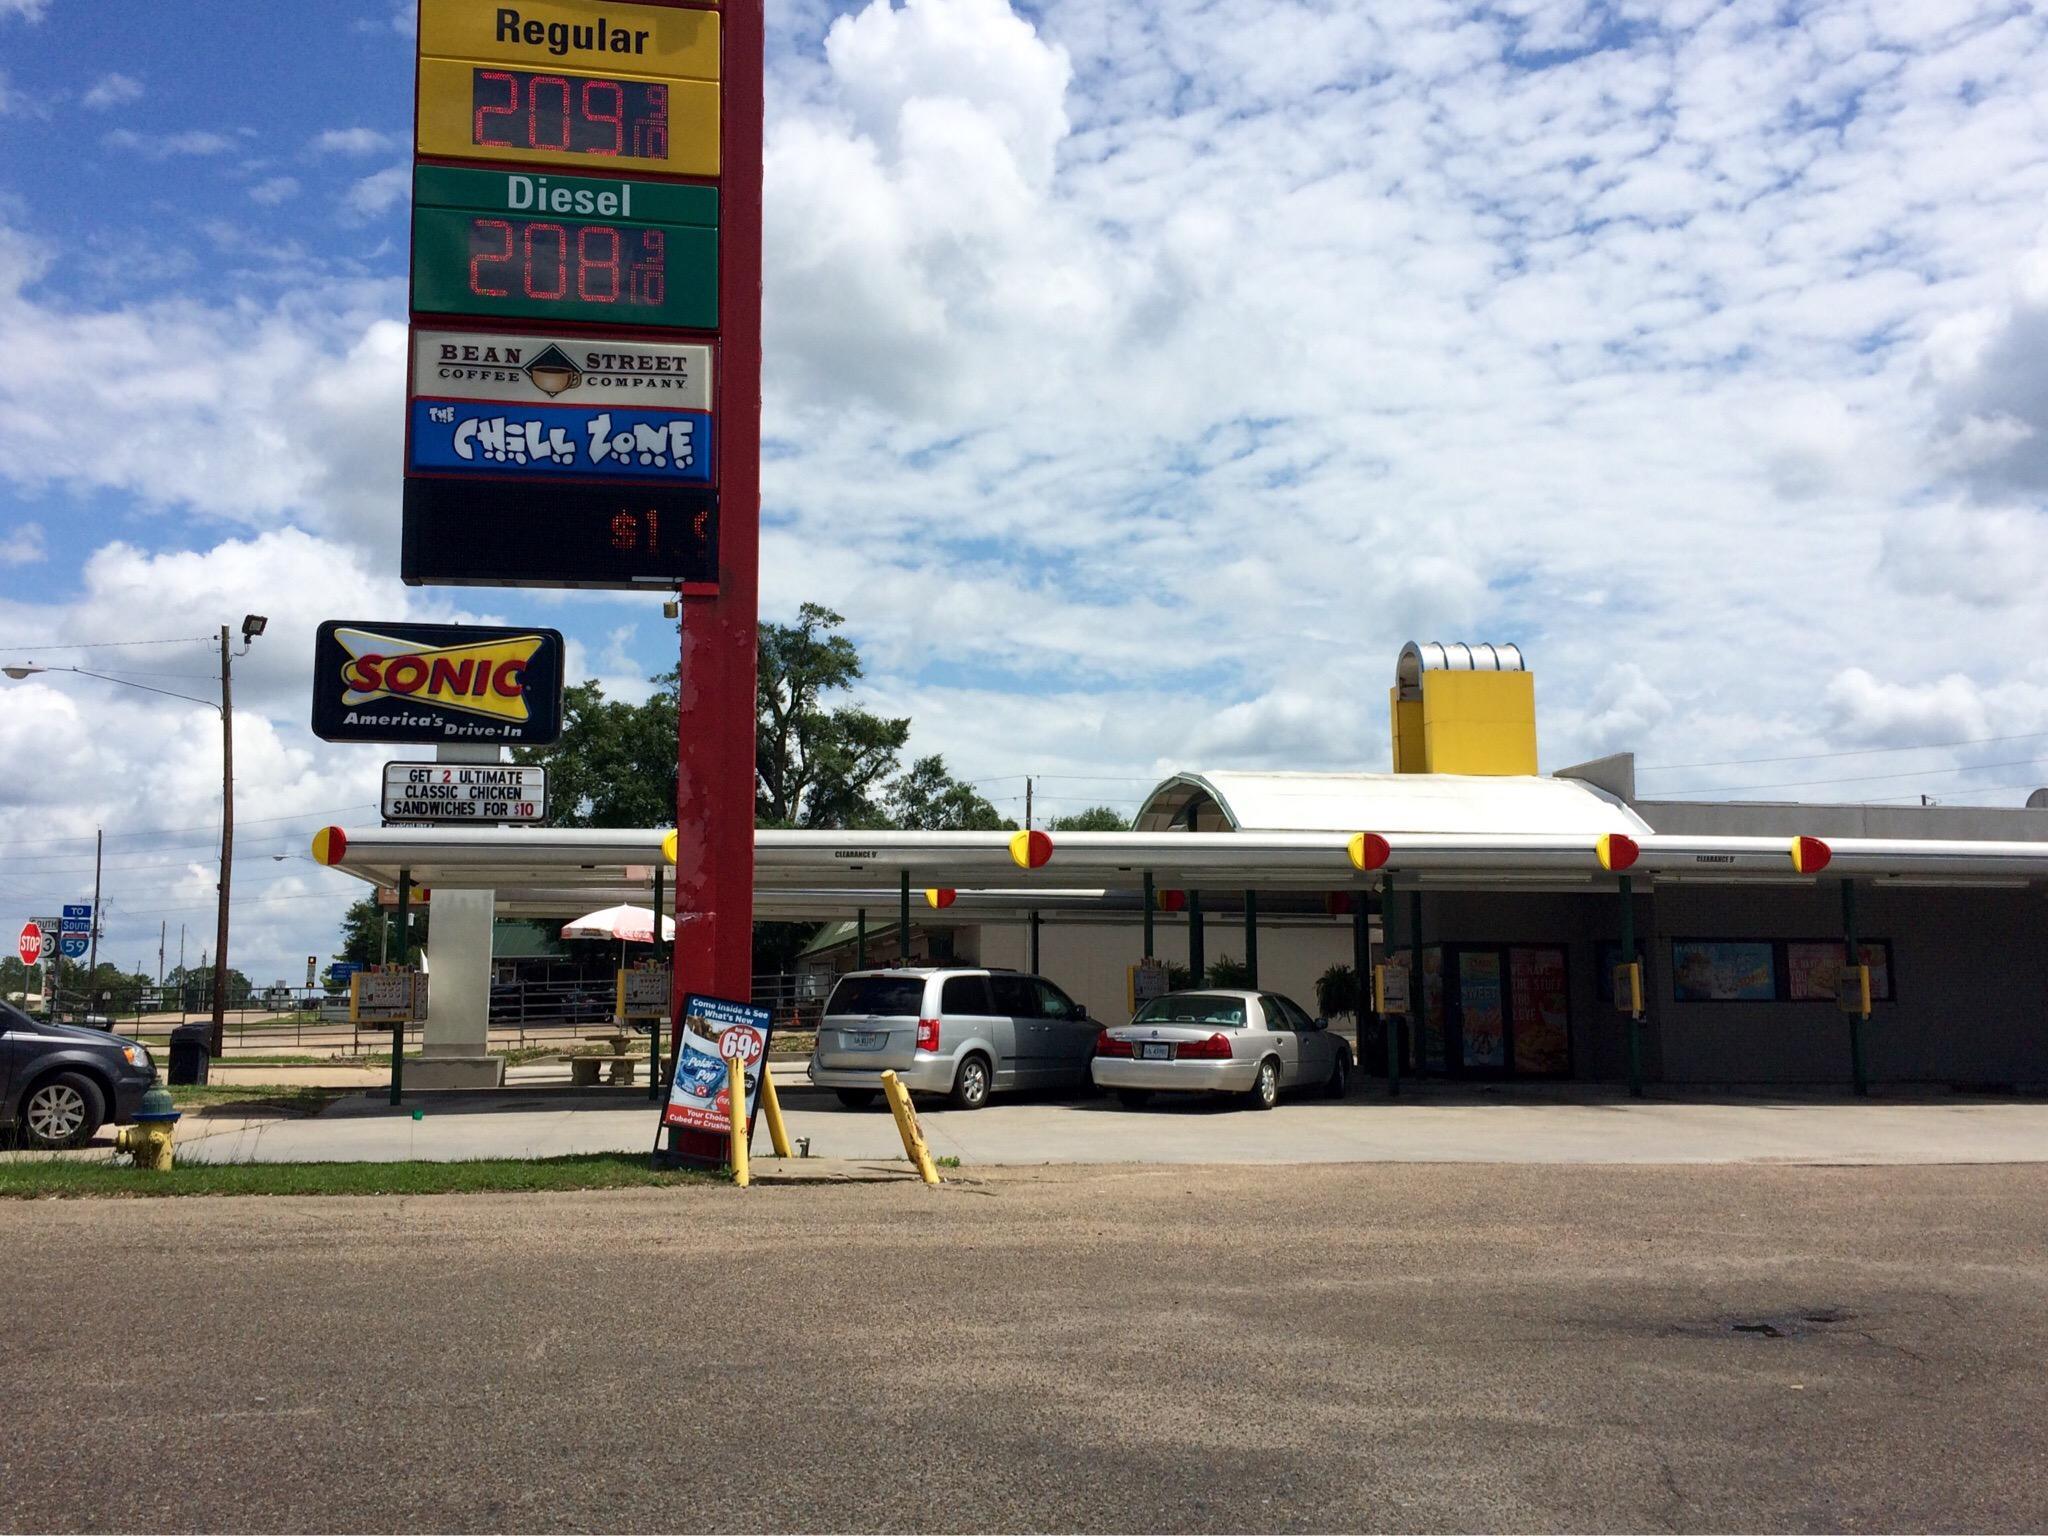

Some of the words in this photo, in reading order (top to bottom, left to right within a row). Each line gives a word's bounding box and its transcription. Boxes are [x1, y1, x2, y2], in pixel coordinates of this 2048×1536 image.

[496, 8, 650, 55] Regular
[475, 71, 624, 157] 209
[508, 175, 631, 217] Diesel
[469, 219, 620, 303] 208
[440, 343, 522, 364] BEAN
[586, 352, 687, 373] STREET
[439, 367, 520, 383] COFFEE
[429, 406, 455, 424] THE
[350, 653, 528, 698] SONIC
[343, 711, 444, 728] America's
[409, 769, 433, 784] GET
[442, 770, 452, 784] 2
[459, 770, 524, 785] ULTIMATE
[405, 784, 459, 799] CLASSIC
[469, 786, 523, 801] CHICKEN
[393, 801, 476, 816] SANDWICHES
[484, 802, 508, 816] FOR
[514, 803, 535, 817] $10
[71, 907, 84, 916] TO
[63, 920, 90, 931] SOUTH
[20, 935, 41, 952] STOP
[65, 940, 85, 953] 59
[692, 999, 717, 1009] Come
[744, 1008, 752, 1016] &
[752, 1009, 769, 1019] See
[704, 1009, 734, 1021] What's
[735, 1015, 754, 1025] New
[687, 1056, 715, 1069] Polar
[695, 1069, 717, 1083] Pop
[669, 1113, 693, 1124] Cubed
[687, 1109, 704, 1118] Your
